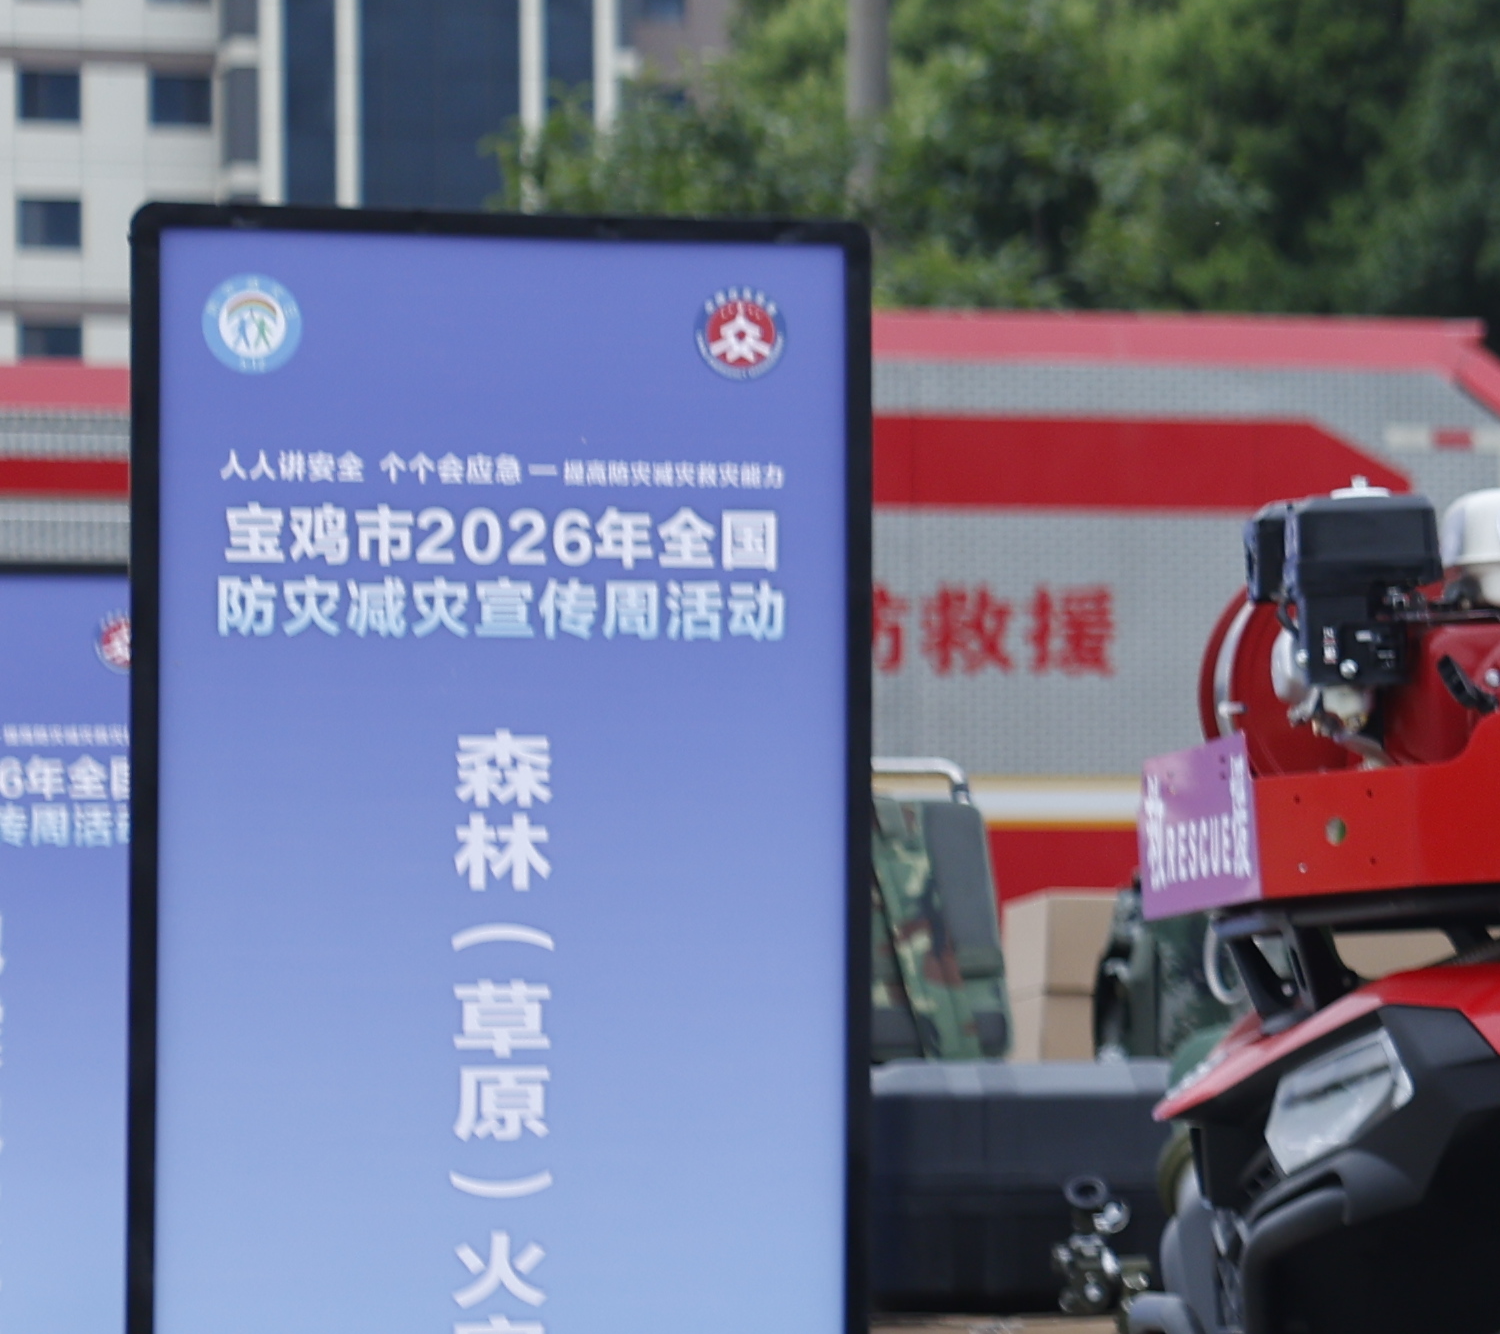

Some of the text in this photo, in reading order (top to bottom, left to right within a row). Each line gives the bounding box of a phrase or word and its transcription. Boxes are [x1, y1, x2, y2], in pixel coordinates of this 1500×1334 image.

[220, 449, 365, 482] 人人讲安全
[379, 451, 522, 486] 个个会应急
[225, 501, 778, 571] 宝鸡市2026年全国
[217, 575, 785, 641] 防灾减灾宣传周活动
